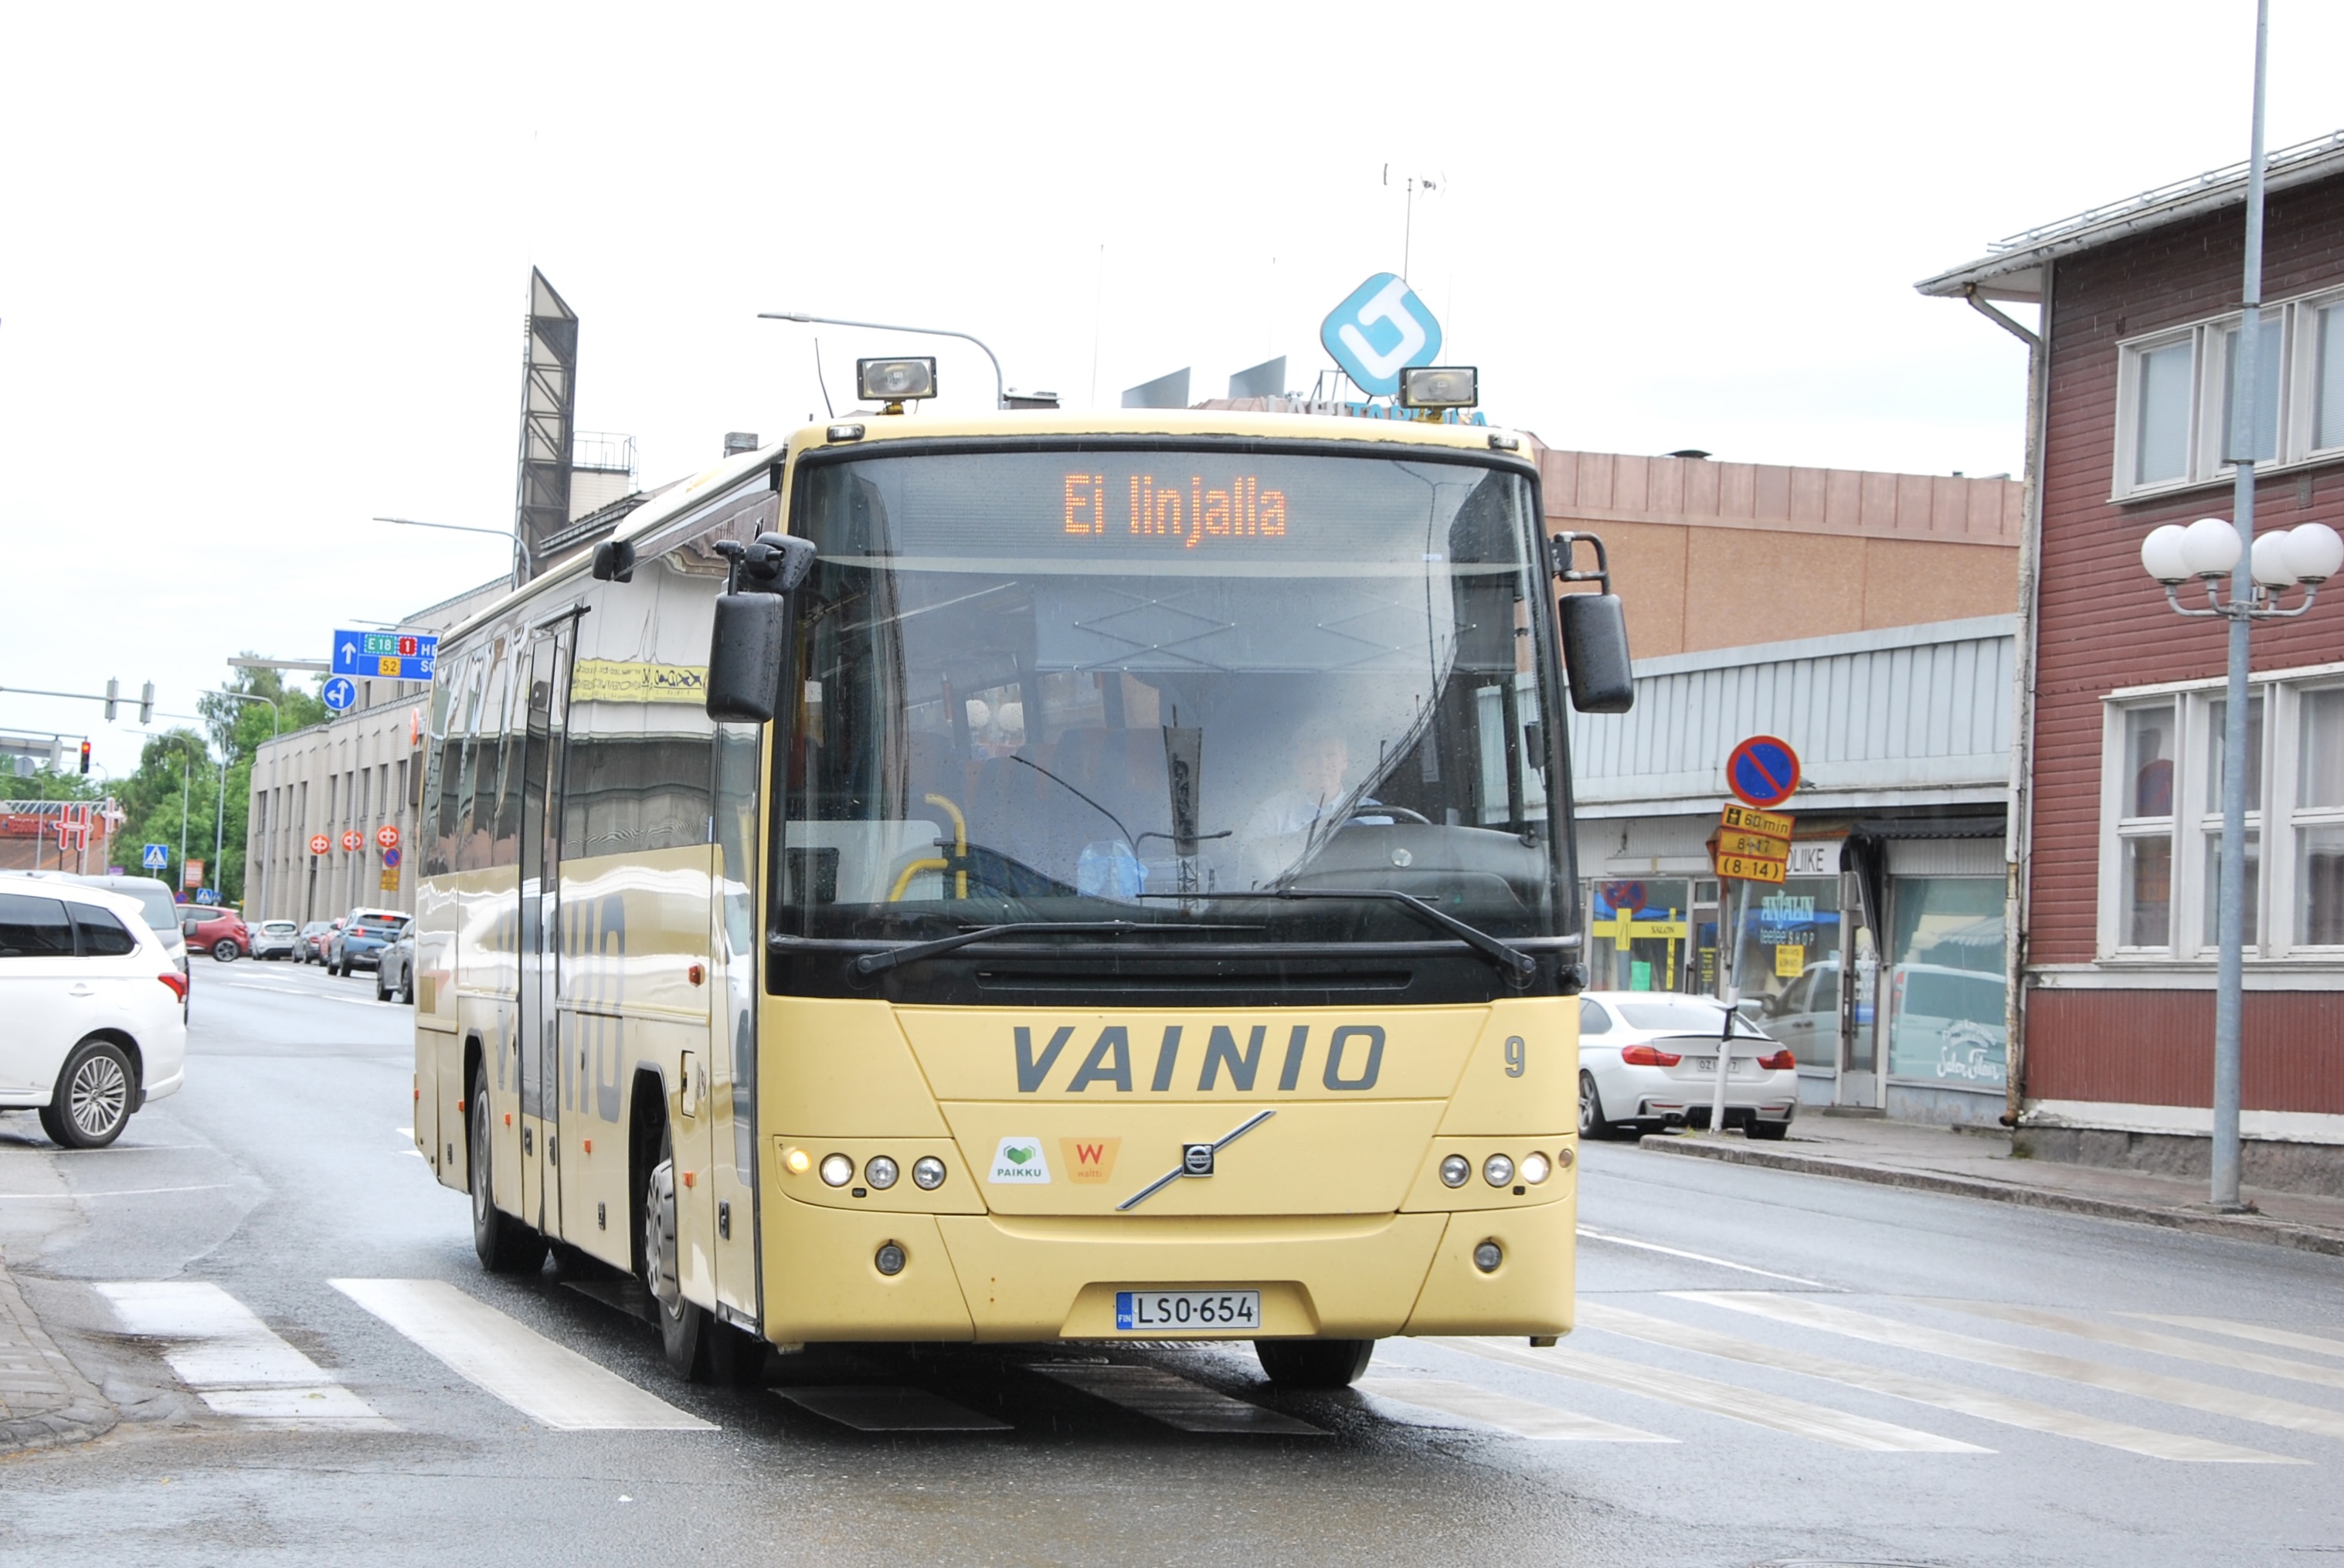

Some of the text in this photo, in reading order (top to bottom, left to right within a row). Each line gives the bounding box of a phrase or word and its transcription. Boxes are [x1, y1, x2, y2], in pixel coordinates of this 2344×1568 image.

[1065, 474, 1286, 549] Ei linjalla
[404, 640, 411, 653] 1
[382, 660, 397, 672] 52
[1744, 813, 1789, 835] 60 min
[1012, 1024, 1387, 1094] VAINIO
[1503, 1035, 1526, 1079] 9
[1076, 1144, 1103, 1164] W
[997, 1169, 1041, 1177] PAIKKU
[1077, 1168, 1102, 1178] waltti
[1118, 1315, 1132, 1323] FIN
[1138, 1297, 1253, 1323] LSO-654
